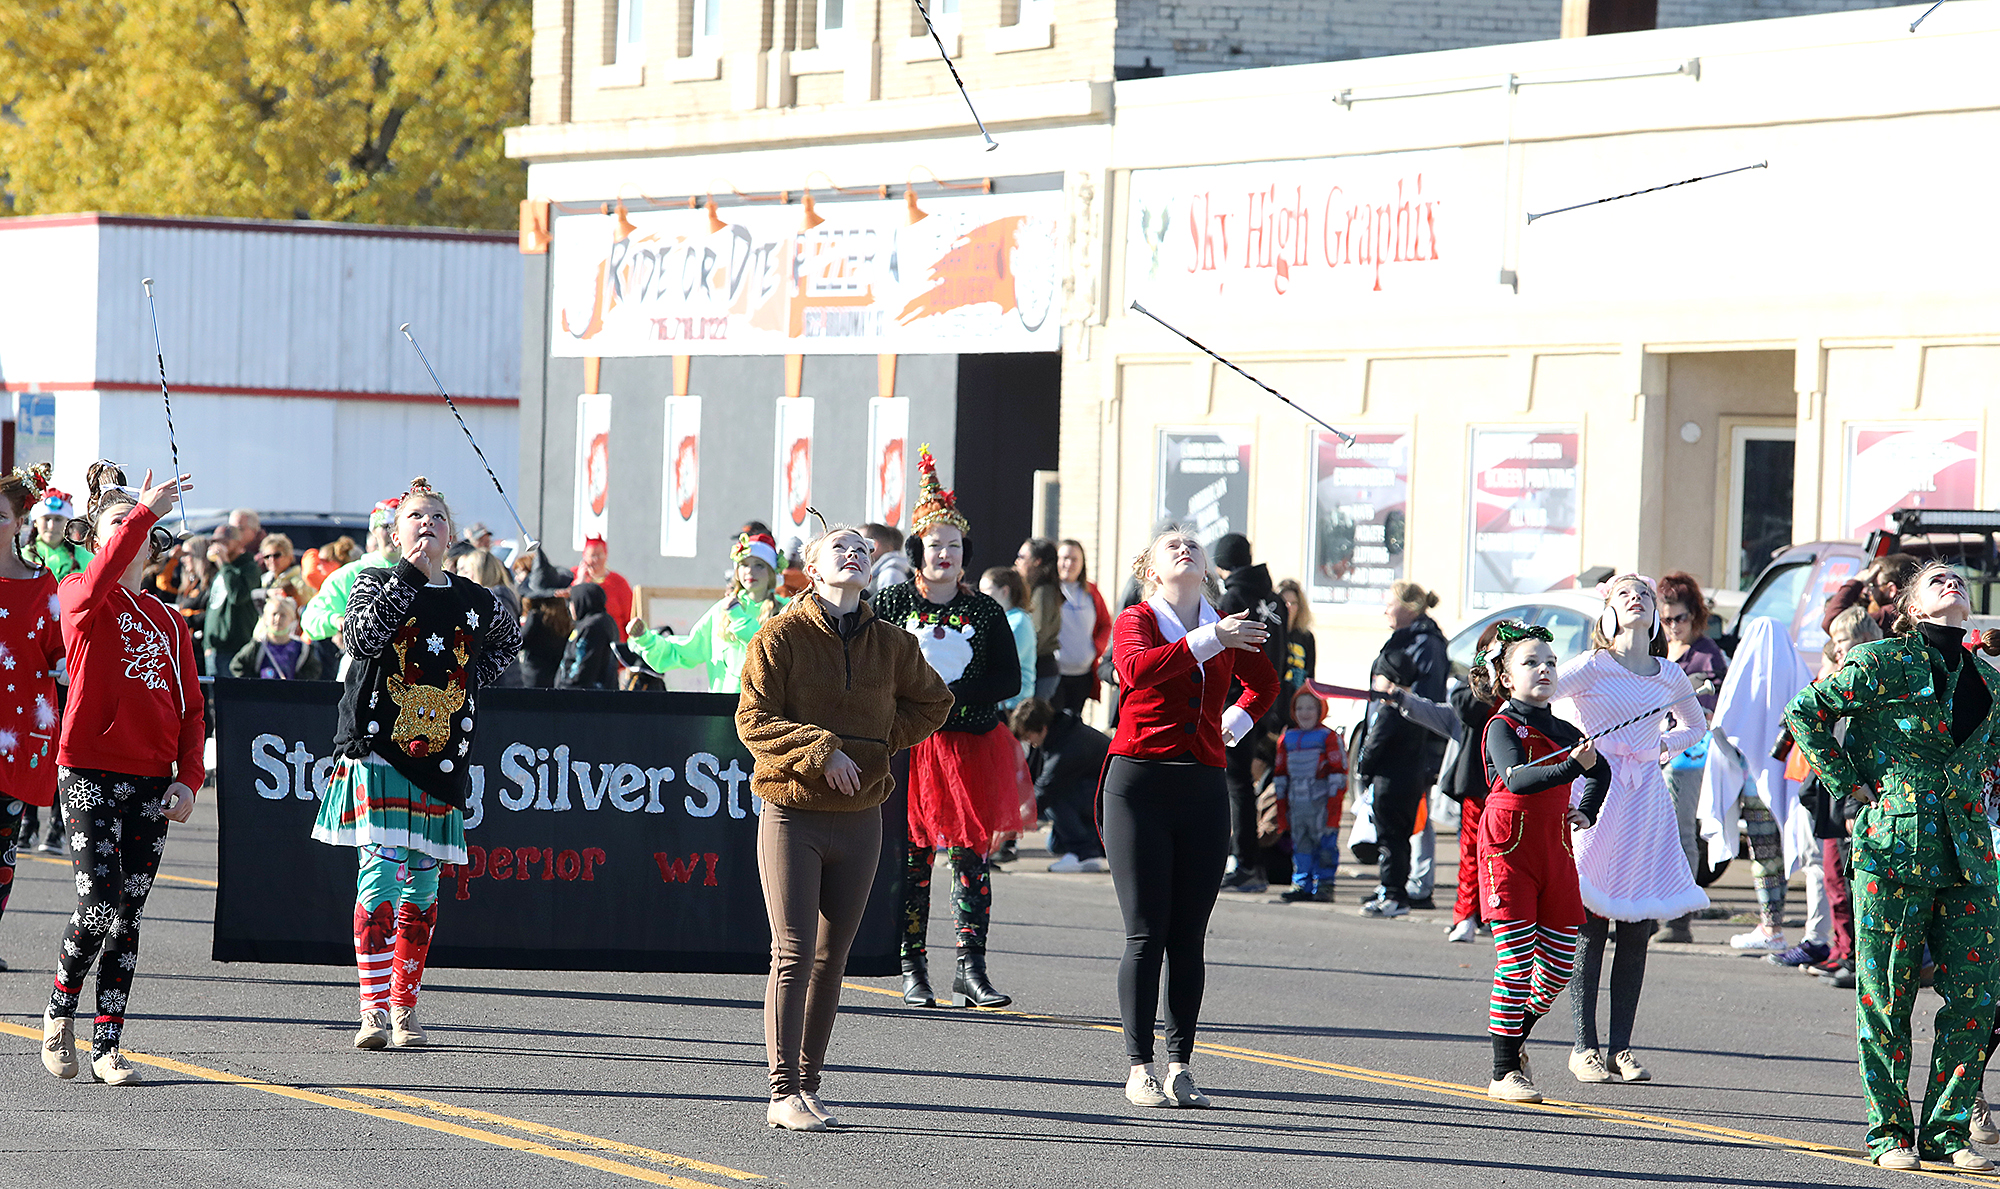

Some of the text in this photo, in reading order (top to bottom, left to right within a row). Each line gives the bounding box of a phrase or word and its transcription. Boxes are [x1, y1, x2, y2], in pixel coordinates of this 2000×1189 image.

[1187, 173, 1441, 295] Sky High Graphix
[905, 610, 970, 626] ARE YOU
[499, 742, 675, 813] Silver
[441, 845, 607, 900] perior
